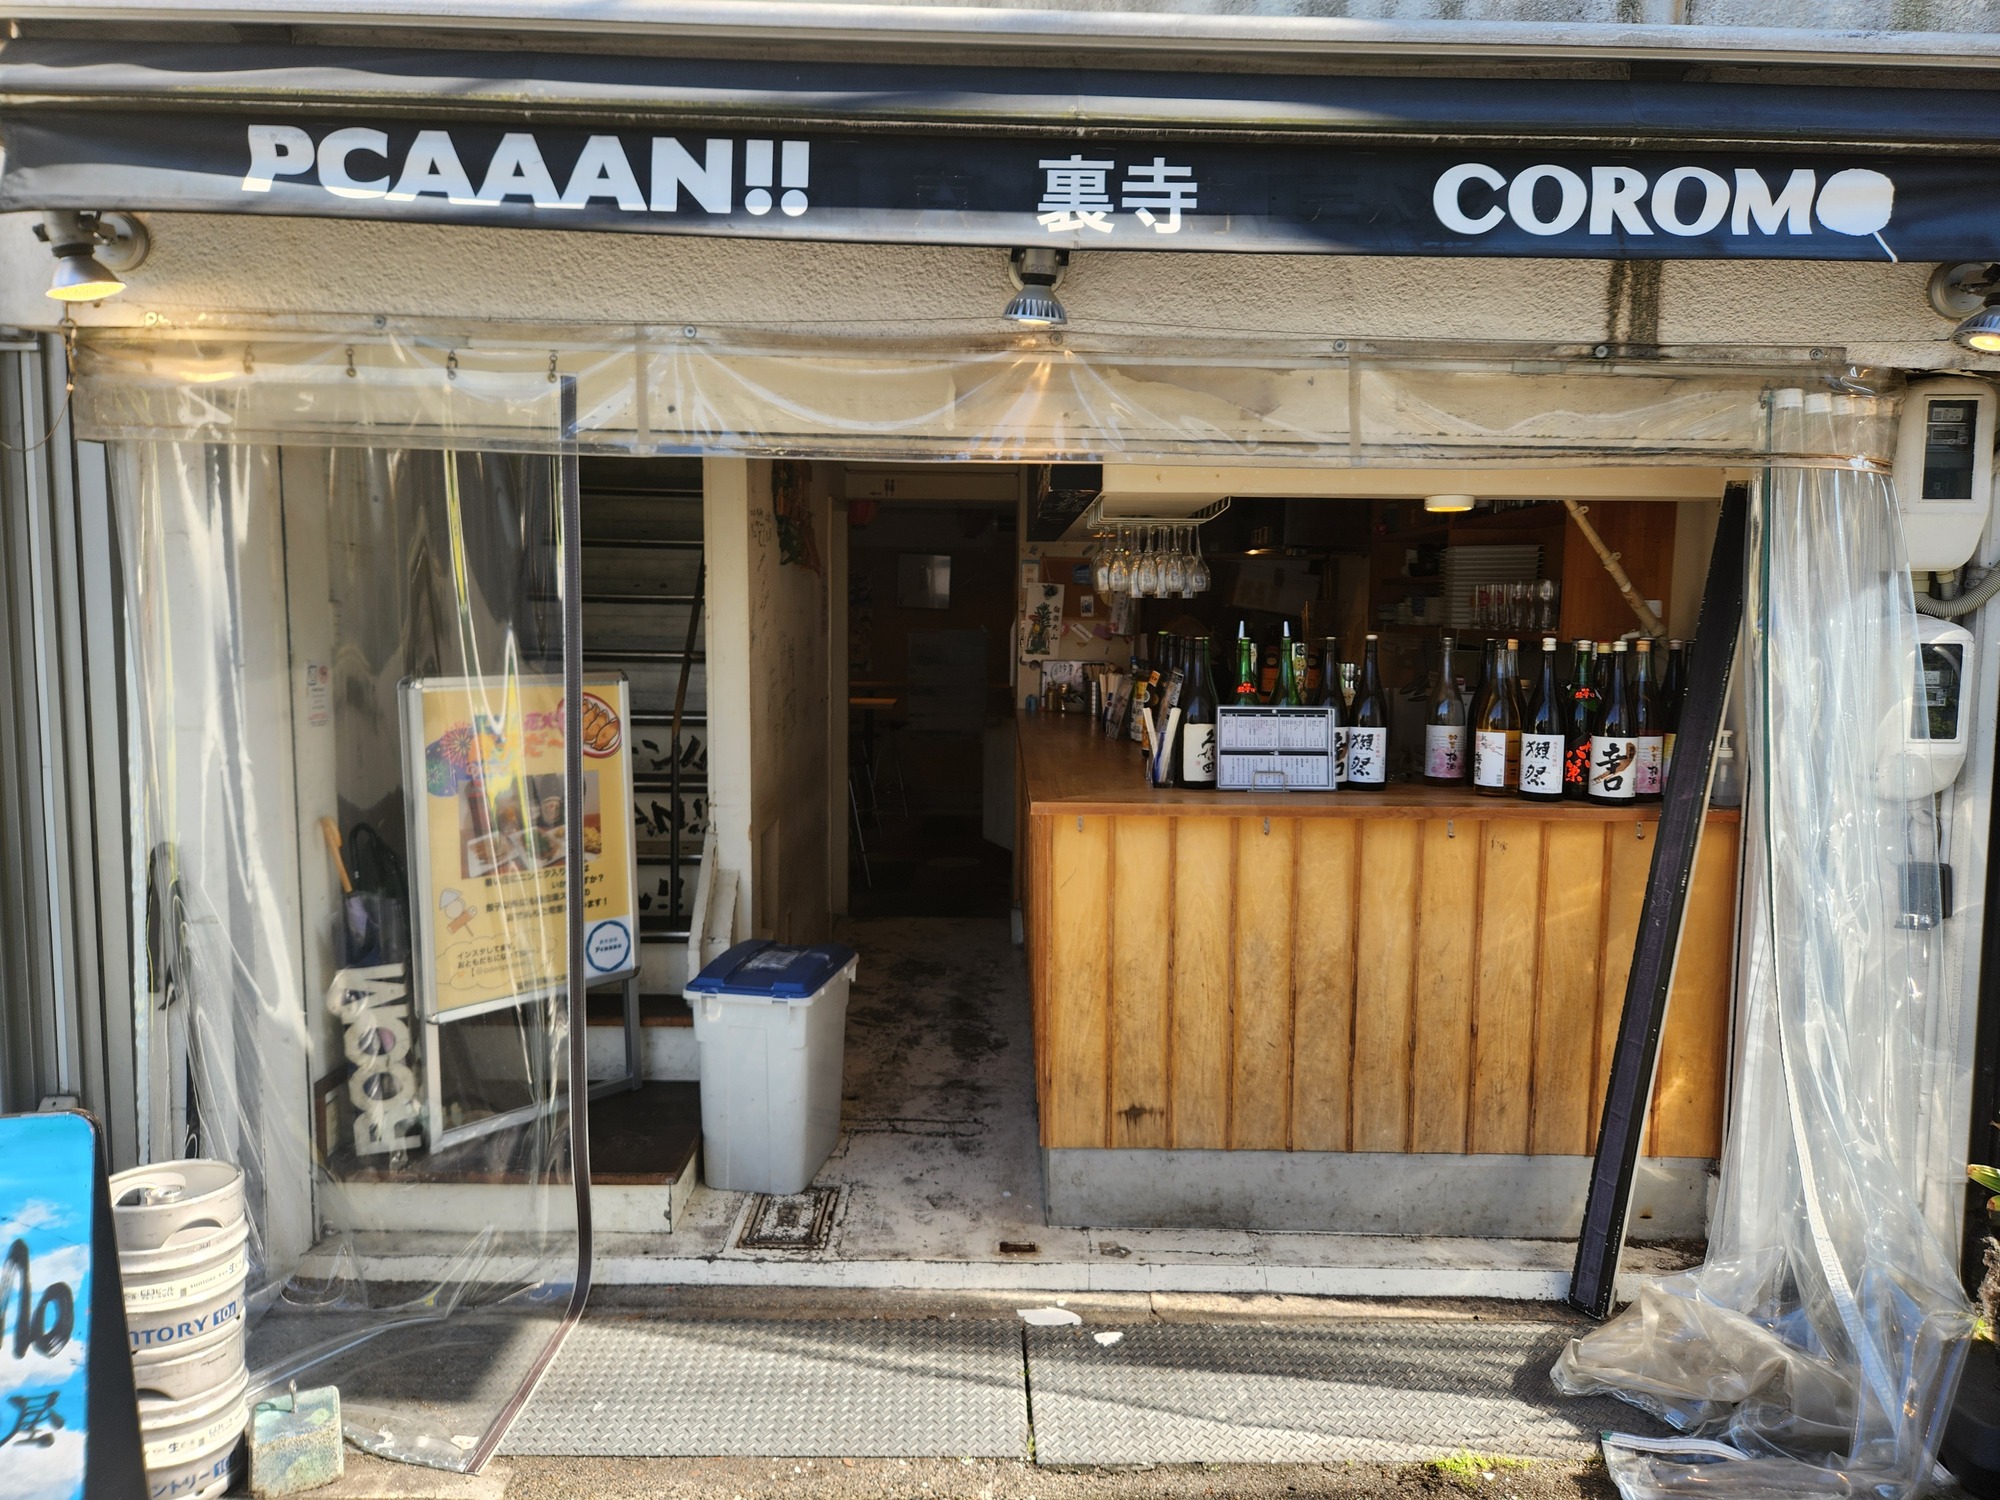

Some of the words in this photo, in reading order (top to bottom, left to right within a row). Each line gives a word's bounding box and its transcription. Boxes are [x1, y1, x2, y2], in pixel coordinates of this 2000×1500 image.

[242, 125, 810, 217] PCAAAN!!
[1037, 155, 1198, 234] 裏寺
[1596, 742, 1628, 792] 辛口
